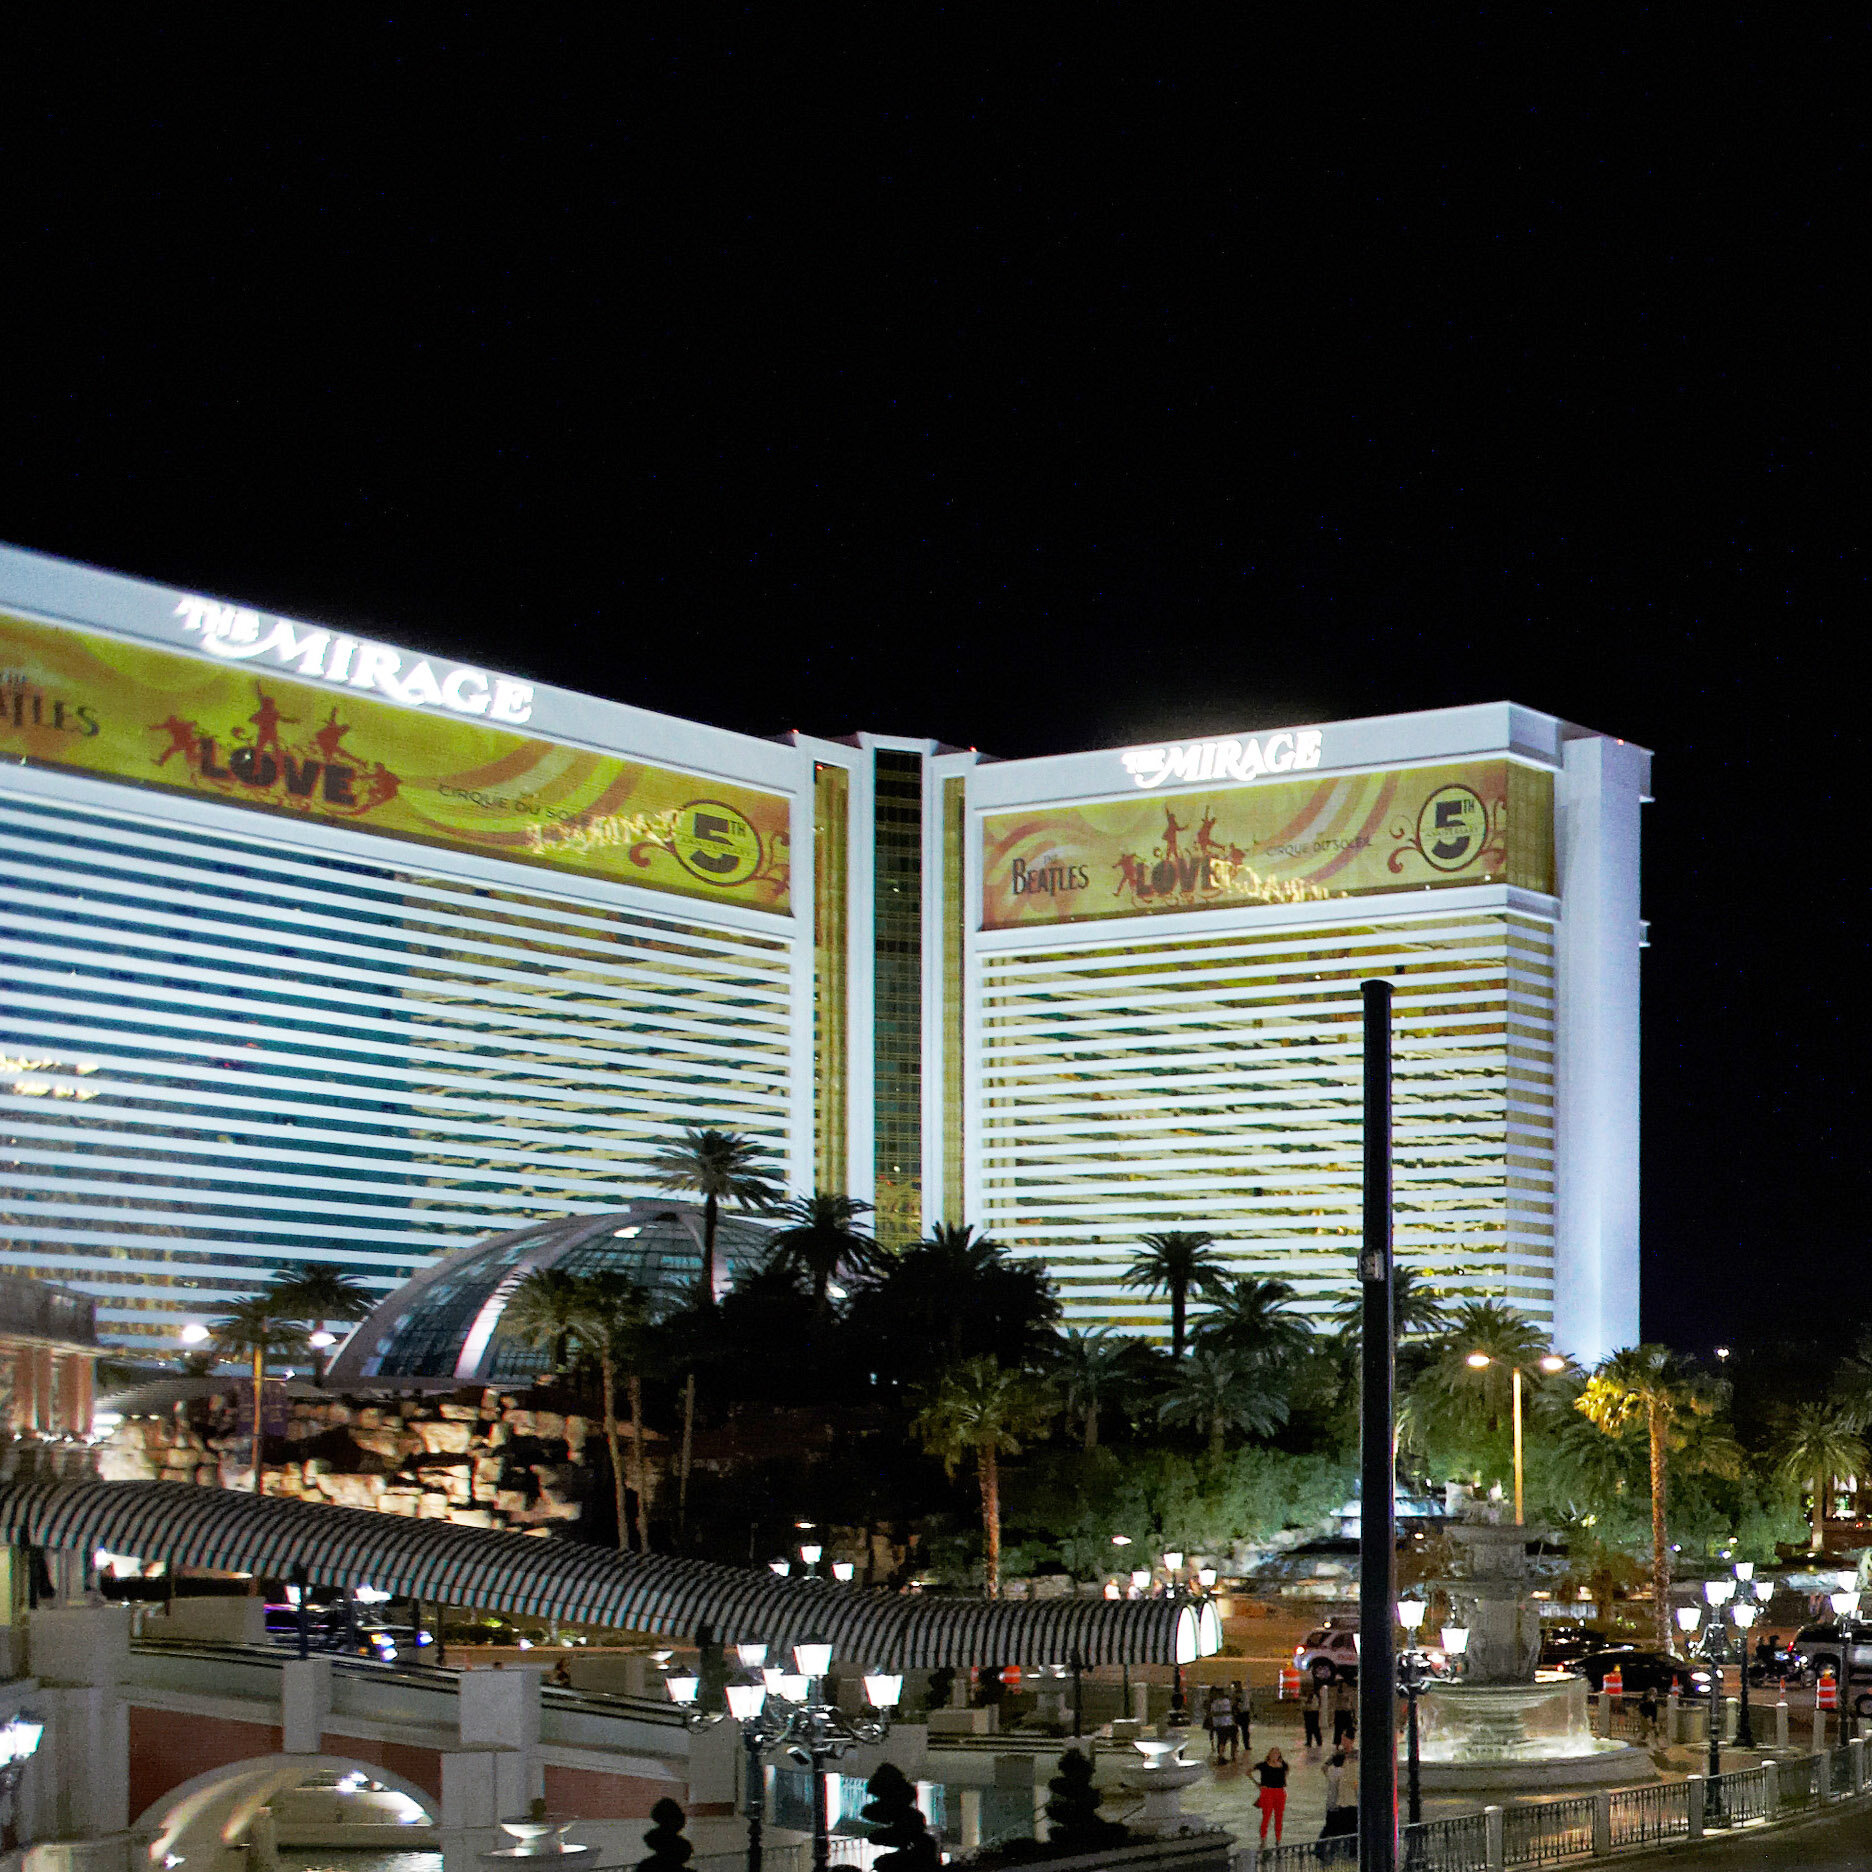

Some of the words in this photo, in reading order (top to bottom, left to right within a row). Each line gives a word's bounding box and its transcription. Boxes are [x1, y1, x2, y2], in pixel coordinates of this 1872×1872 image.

[173, 598, 260, 641] THE
[201, 618, 534, 725] MIRAGE
[200, 736, 358, 807] LOVE
[1134, 730, 1324, 789] MIRAGE
[1013, 857, 1090, 896] BEATLES
[1136, 856, 1217, 897] LOVE
